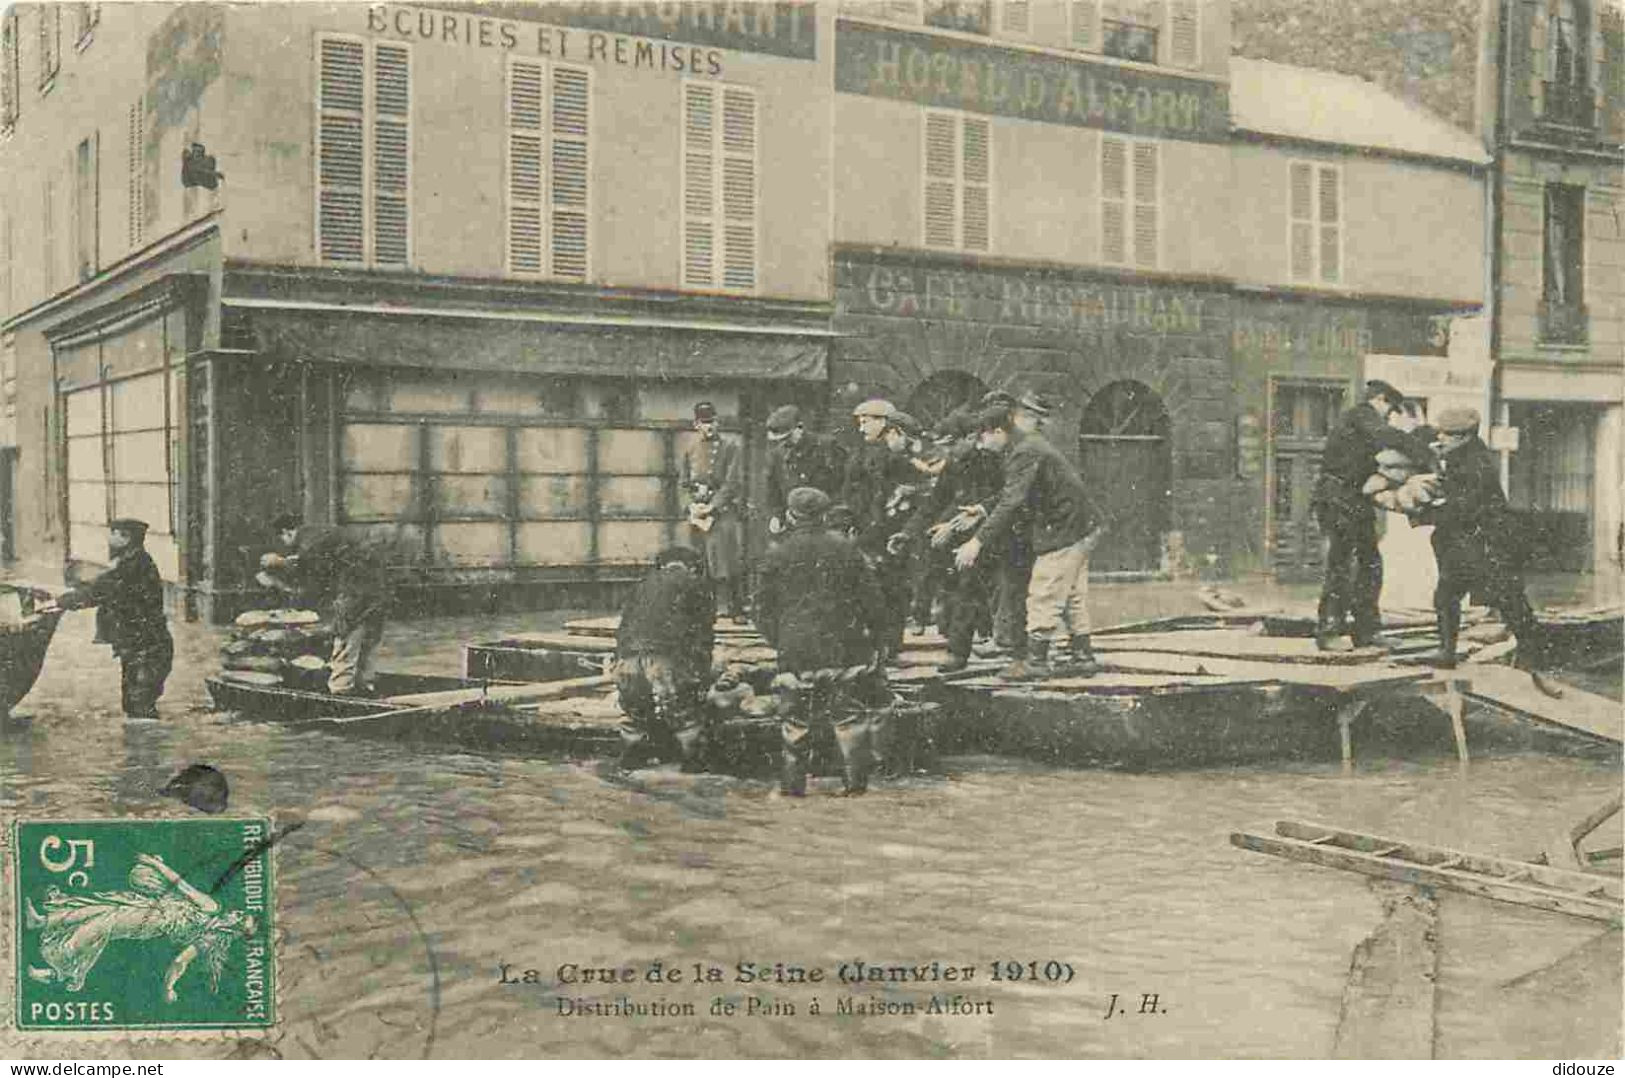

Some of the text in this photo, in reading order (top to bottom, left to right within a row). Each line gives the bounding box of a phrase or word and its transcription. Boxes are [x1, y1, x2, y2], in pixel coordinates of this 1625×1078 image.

[534, 27, 568, 58] ET
[588, 32, 723, 76] REMISES
[243, 824, 264, 914] REUBLIQUE
[31, 1001, 115, 1022] POSTES
